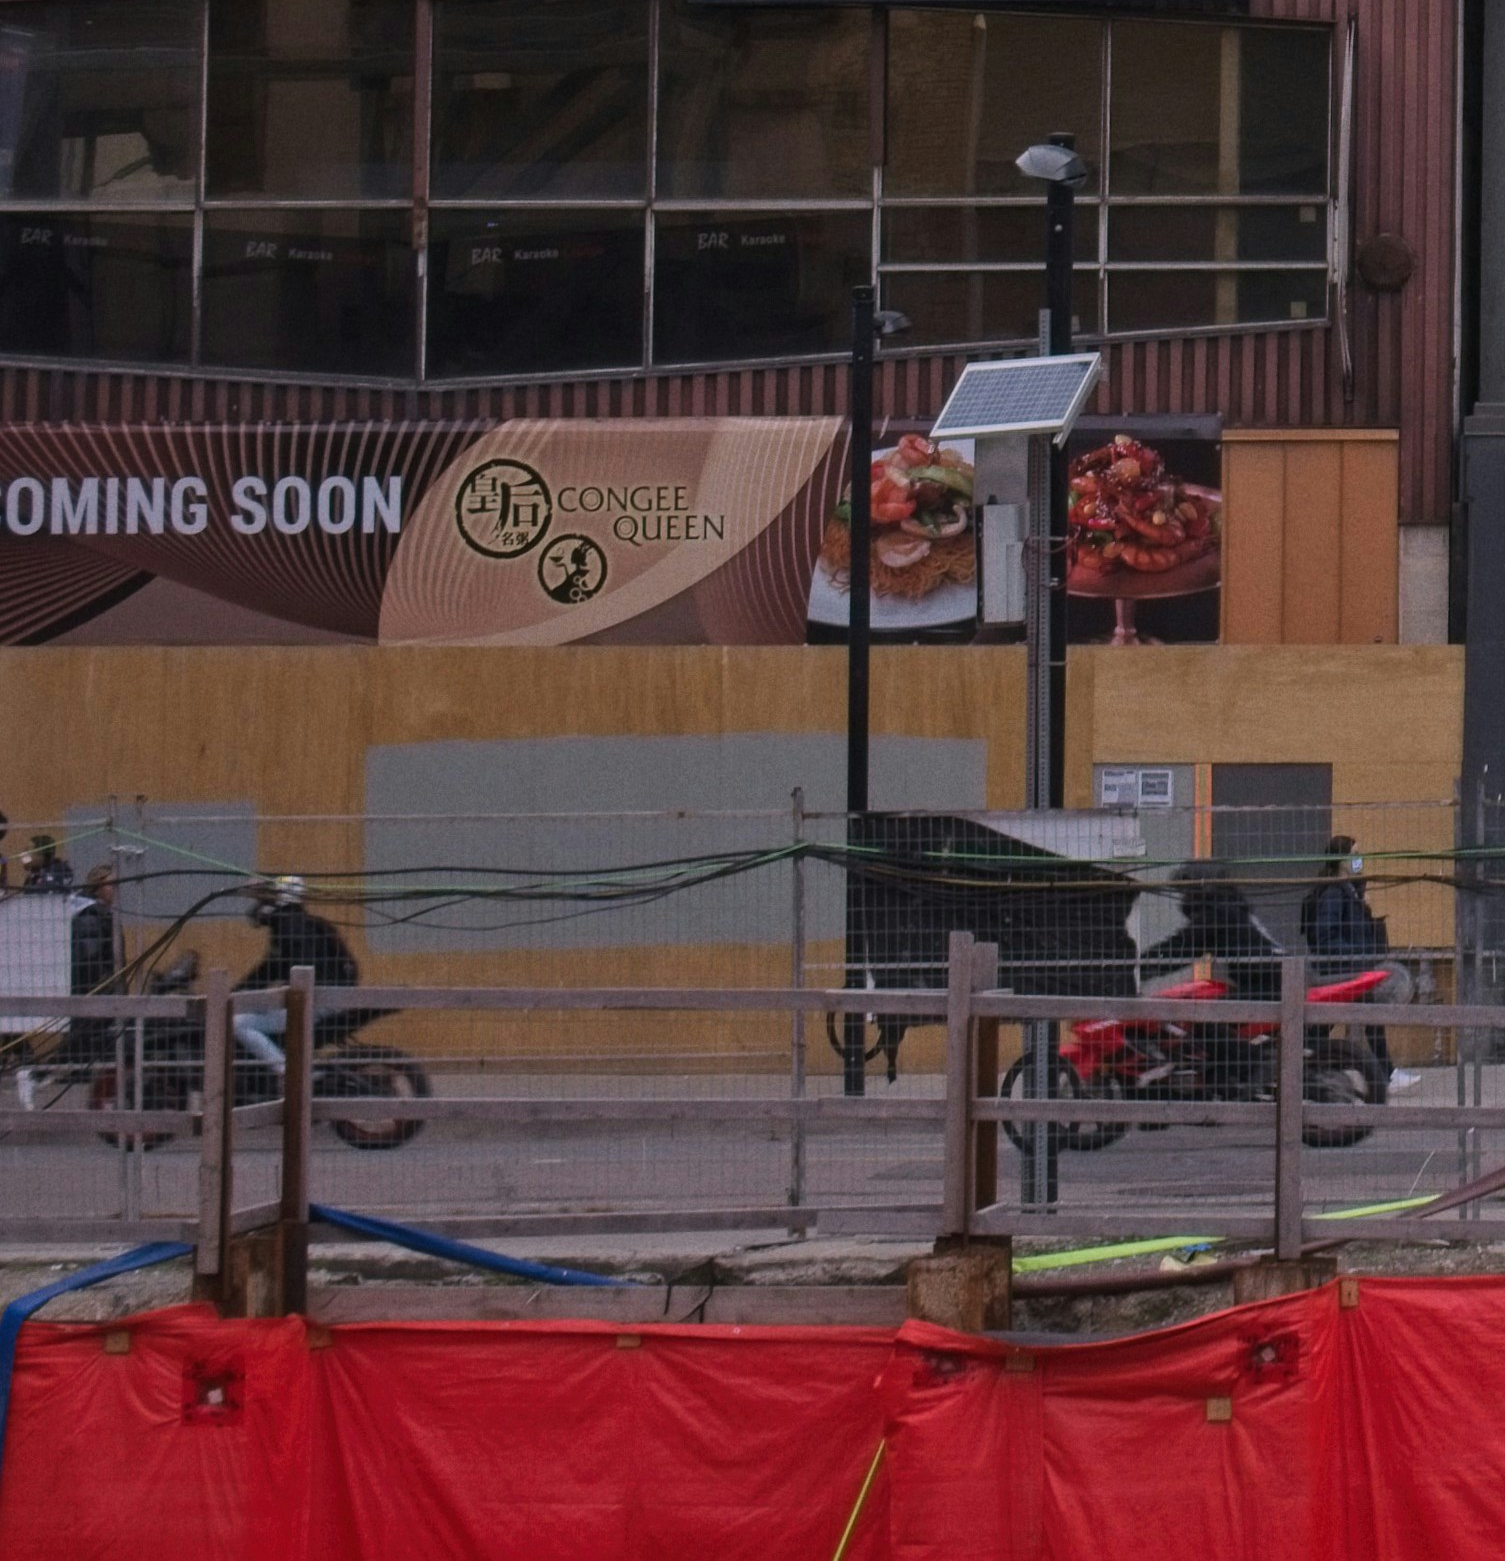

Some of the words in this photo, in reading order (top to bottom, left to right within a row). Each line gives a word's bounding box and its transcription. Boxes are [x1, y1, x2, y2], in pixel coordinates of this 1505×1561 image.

[246, 241, 278, 260] BAR
[288, 247, 334, 262] Karaoke
[697, 231, 730, 250] BAR
[740, 233, 787, 247] Karaoke
[471, 247, 504, 265] BAR
[513, 247, 560, 261] Karaoke
[0, 476, 209, 536] OMING
[230, 475, 402, 536] SOON
[467, 474, 542, 544] 皇后
[557, 485, 689, 513] CONGEE
[613, 514, 726, 547] QUEEN
